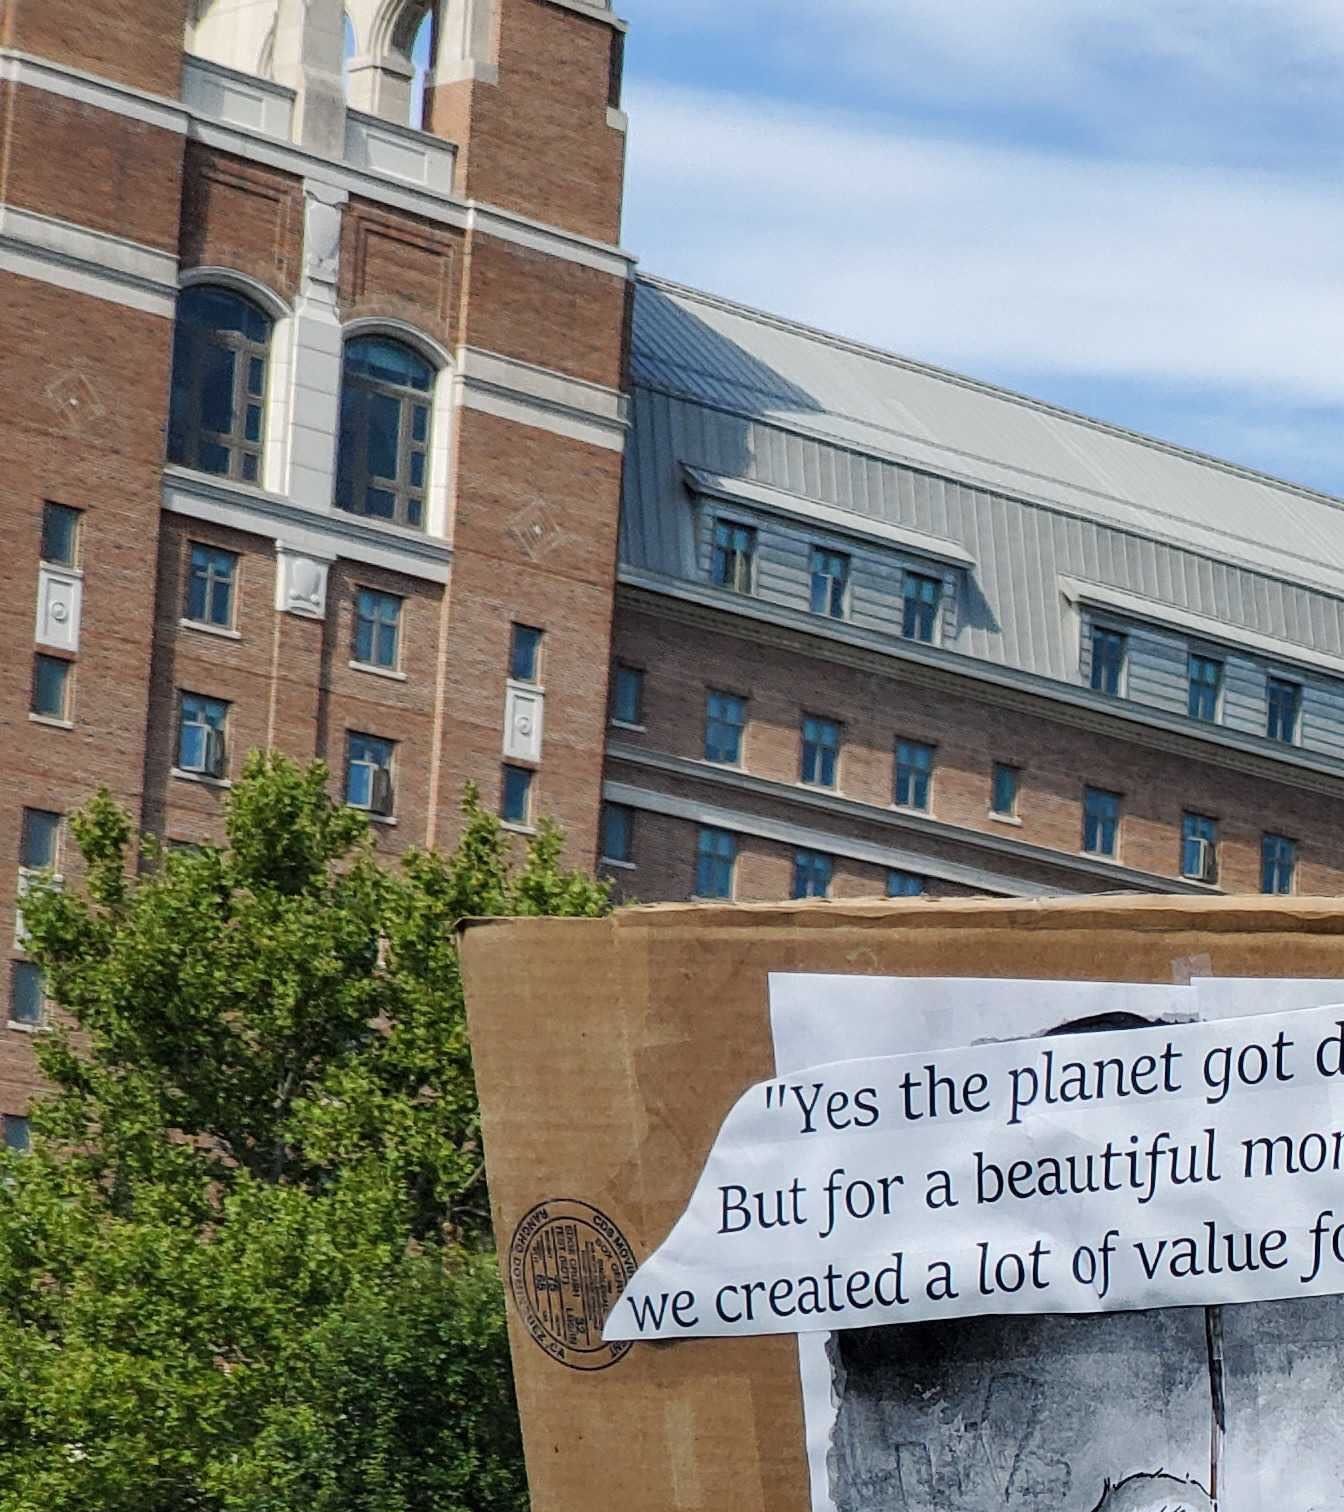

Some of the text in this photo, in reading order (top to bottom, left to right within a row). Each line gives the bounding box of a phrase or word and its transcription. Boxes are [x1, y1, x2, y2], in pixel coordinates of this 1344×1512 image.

[764, 1082, 879, 1134] "Yes
[899, 1064, 991, 1122] the
[1005, 1042, 1183, 1125] planet
[1202, 1029, 1295, 1105] got
[717, 1182, 807, 1235] But
[819, 1168, 904, 1239] for
[926, 1169, 959, 1211] a
[972, 1128, 1221, 1205] beautiful
[627, 1289, 700, 1333] we
[715, 1252, 905, 1324] created
[926, 1258, 959, 1300] a
[977, 1237, 1051, 1294] lot
[1072, 1229, 1120, 1298] of
[1138, 1220, 1288, 1280] value
